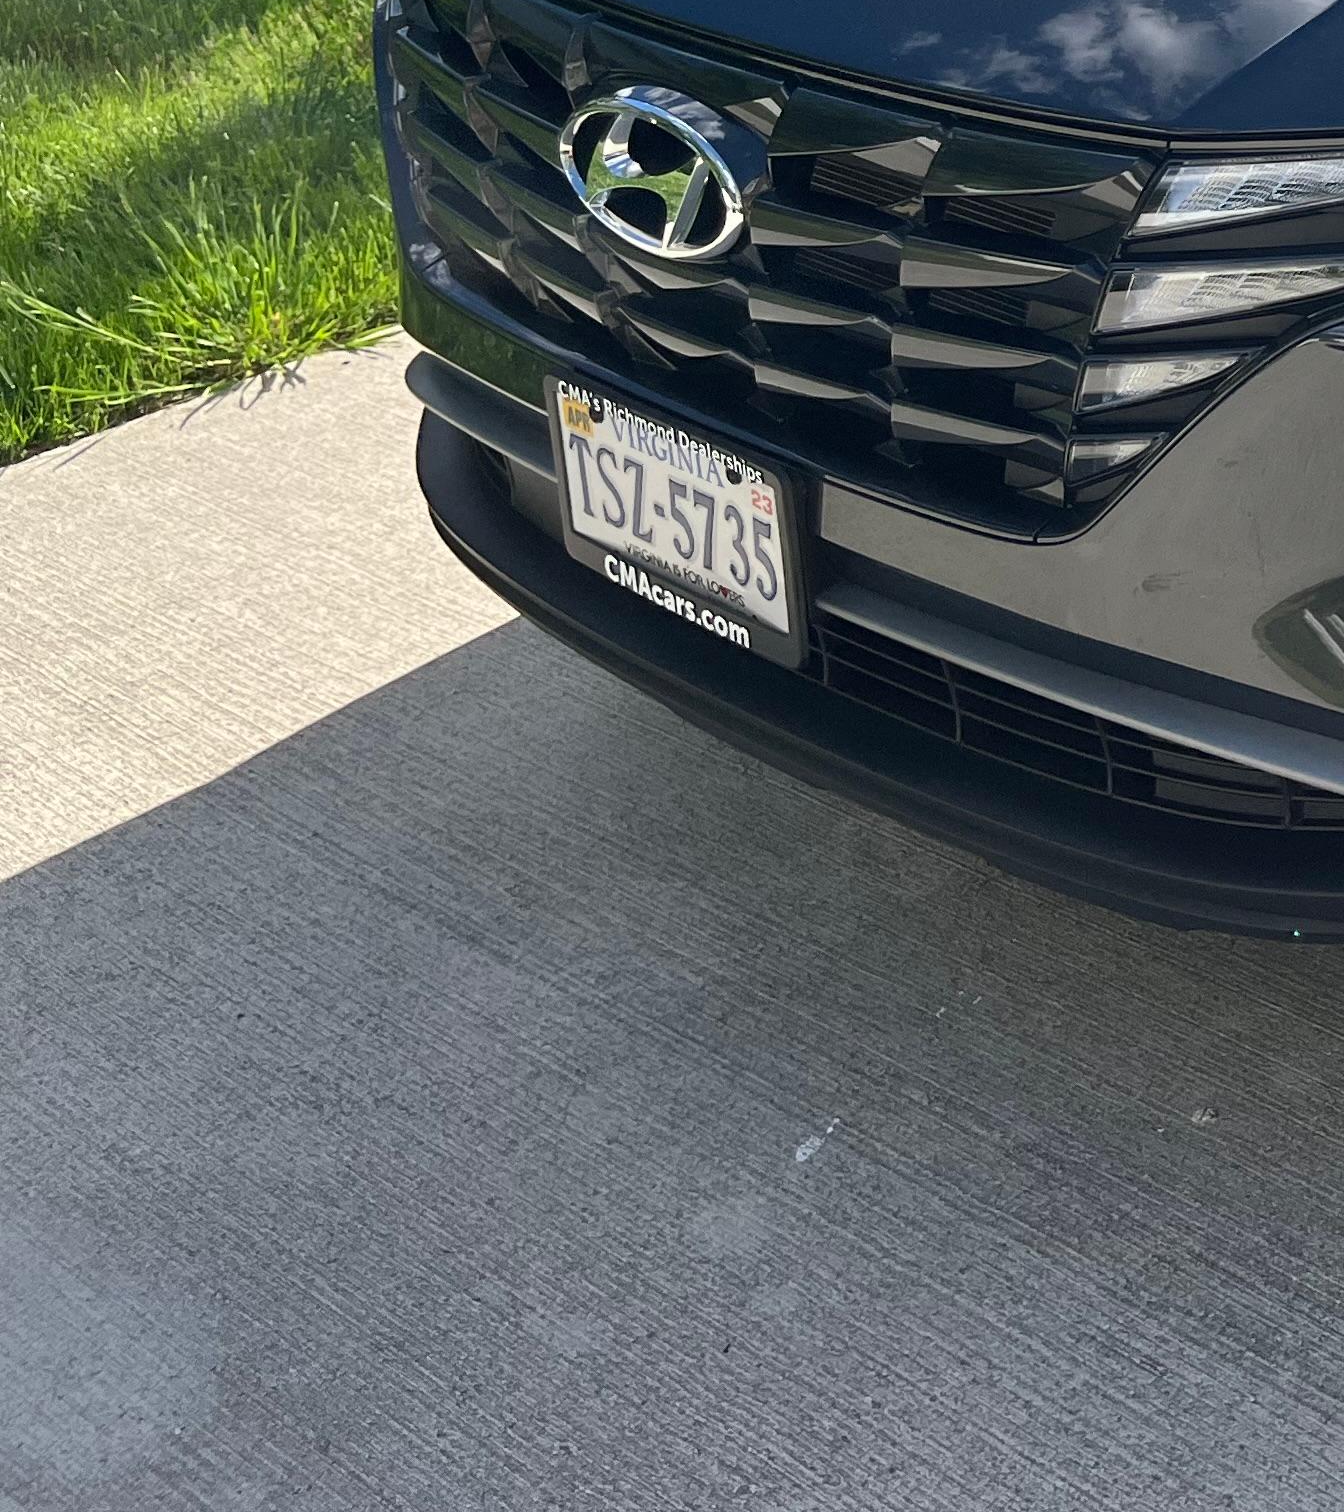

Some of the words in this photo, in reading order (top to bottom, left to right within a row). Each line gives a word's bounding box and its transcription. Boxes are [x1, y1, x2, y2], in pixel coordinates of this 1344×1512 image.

[558, 380, 601, 412] CMA's
[603, 398, 675, 445] Richmond
[678, 430, 763, 484] Dealerships
[611, 419, 724, 487] VIRGINIA
[569, 435, 778, 602] TSZ-5735
[751, 490, 773, 516] 23
[604, 554, 750, 649] CMAcars.com
